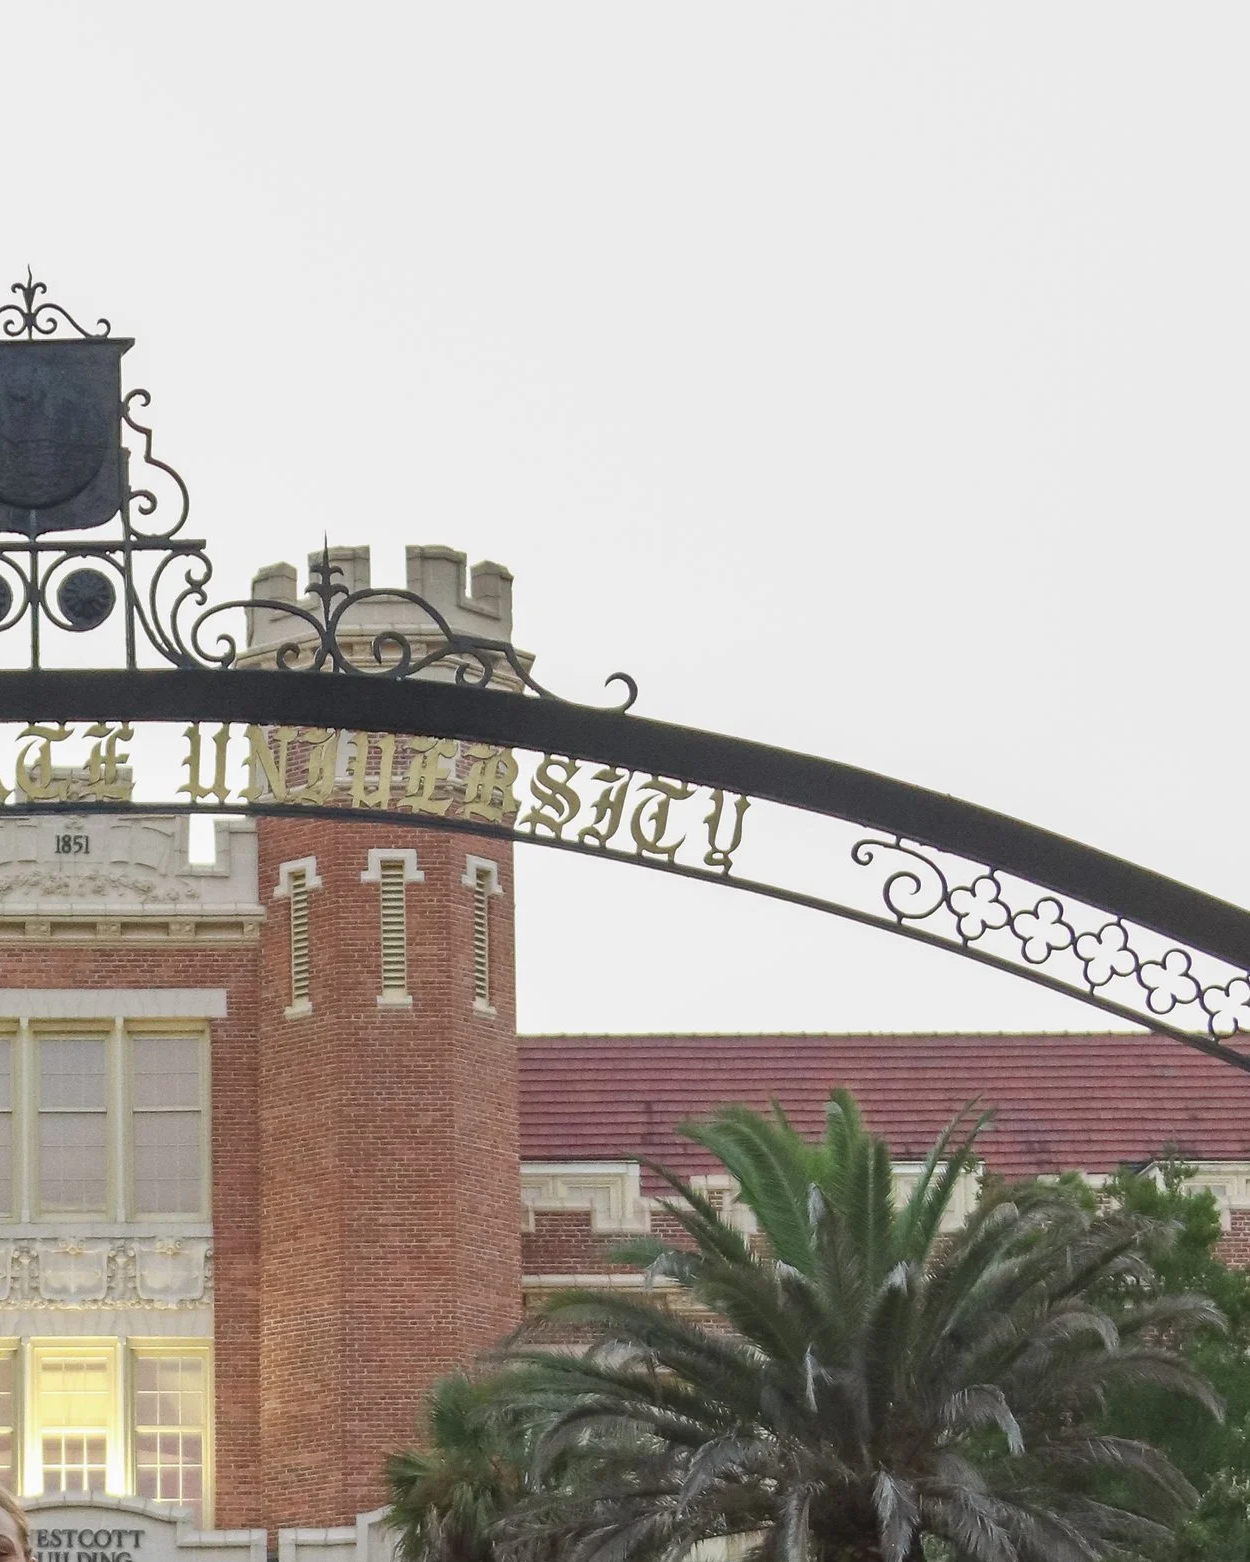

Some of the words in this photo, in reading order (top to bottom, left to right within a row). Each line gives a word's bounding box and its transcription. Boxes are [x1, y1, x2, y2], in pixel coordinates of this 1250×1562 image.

[176, 722, 751, 877] UNIVERSITY
[54, 834, 90, 854] 1851
[31, 1528, 146, 1549] ESTCOTT
